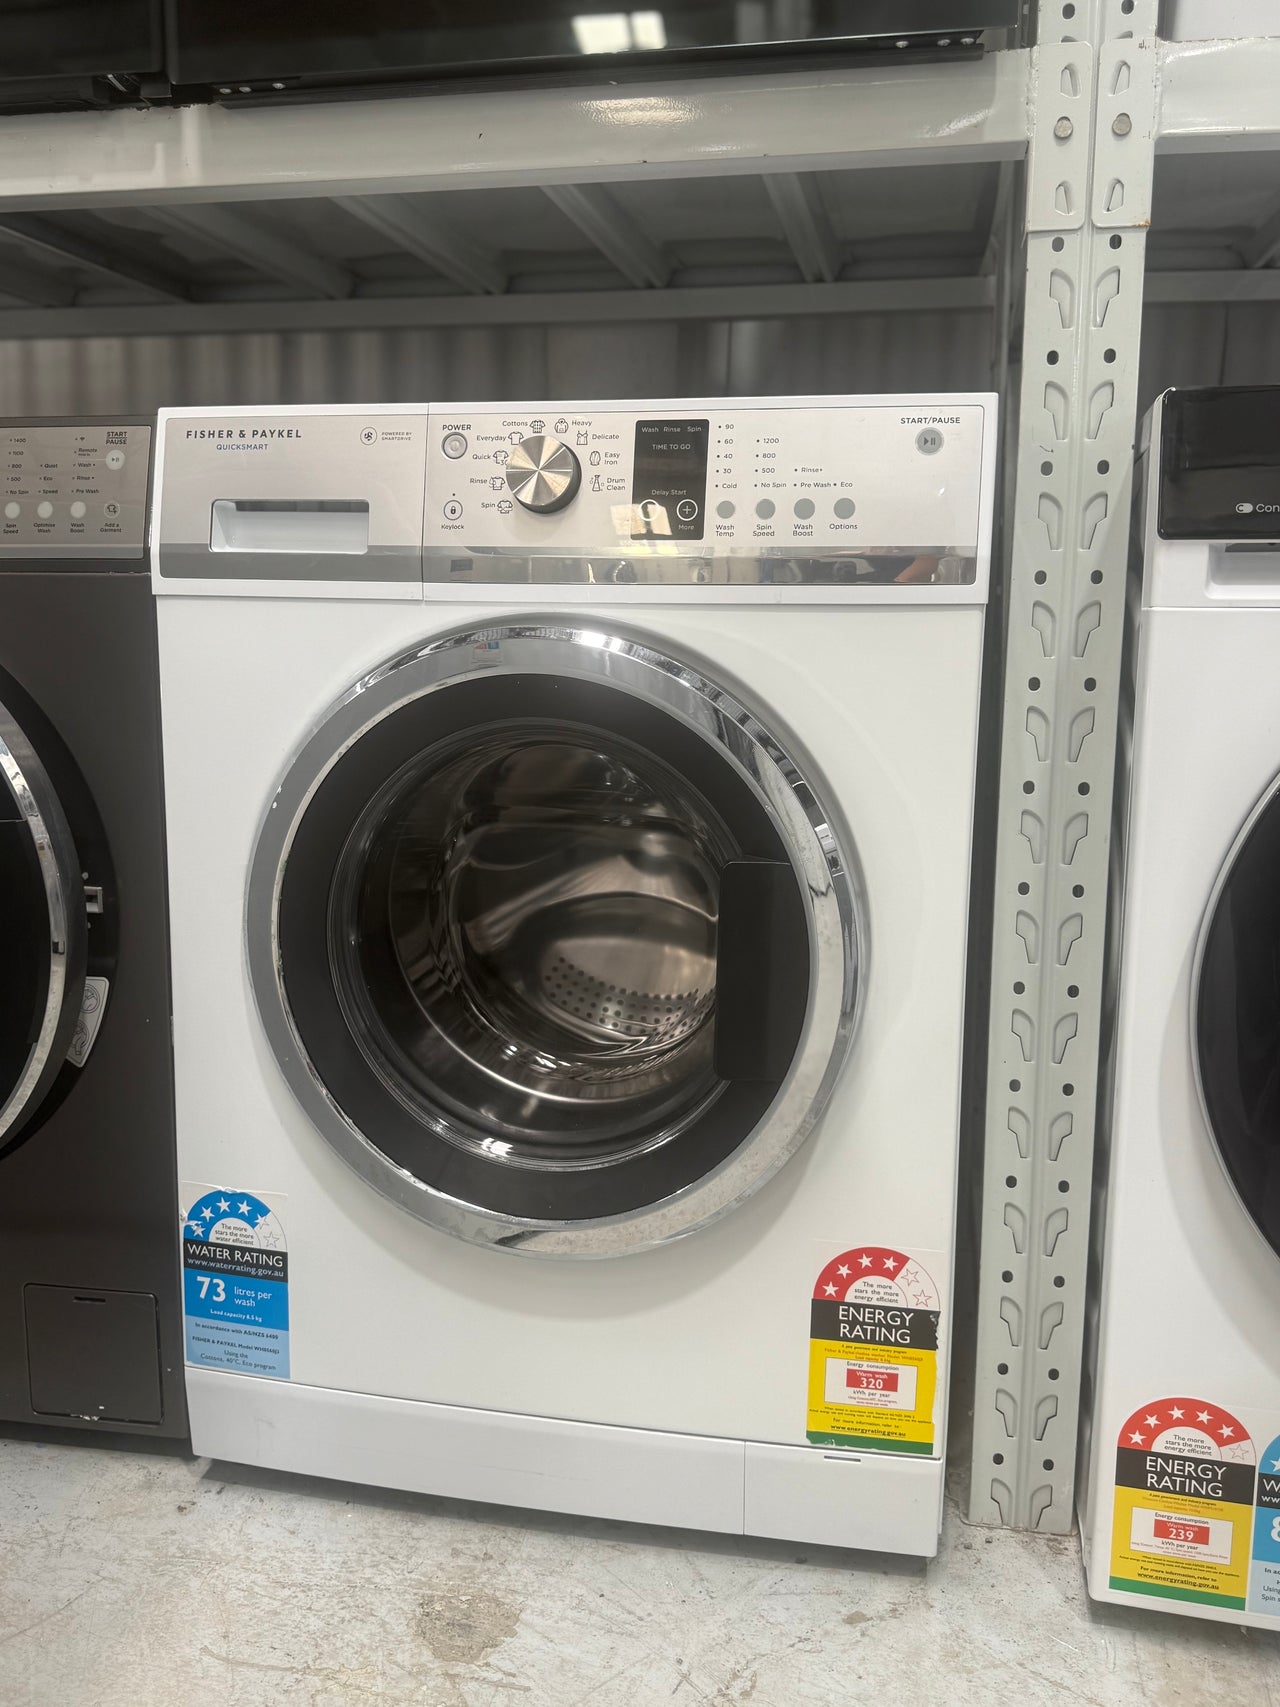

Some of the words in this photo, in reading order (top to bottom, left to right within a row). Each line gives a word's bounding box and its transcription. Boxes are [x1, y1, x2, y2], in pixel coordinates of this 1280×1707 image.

[186, 430, 233, 439] FISHER
[239, 430, 246, 438] &
[252, 429, 302, 438] PAYKEL
[651, 489, 669, 497] Delay
[187, 1243, 231, 1260] WATER
[234, 1250, 283, 1267] RATING
[187, 1258, 284, 1277] www.waterrating.gov.au
[197, 1276, 226, 1302] 73
[234, 1286, 256, 1297] litres
[257, 1291, 273, 1300] per
[234, 1298, 256, 1307] wash
[839, 1305, 914, 1327] ENERGY
[840, 1323, 911, 1344] RATING
[847, 1361, 864, 1369] Energy
[860, 1377, 883, 1389] 320
[1164, 1445, 1185, 1453] energy
[1146, 1456, 1227, 1480] ENERGY
[1147, 1473, 1223, 1497] RATING
[1154, 1512, 1173, 1520] Energy
[1174, 1515, 1209, 1525] consumption
[1168, 1528, 1194, 1541] 239
